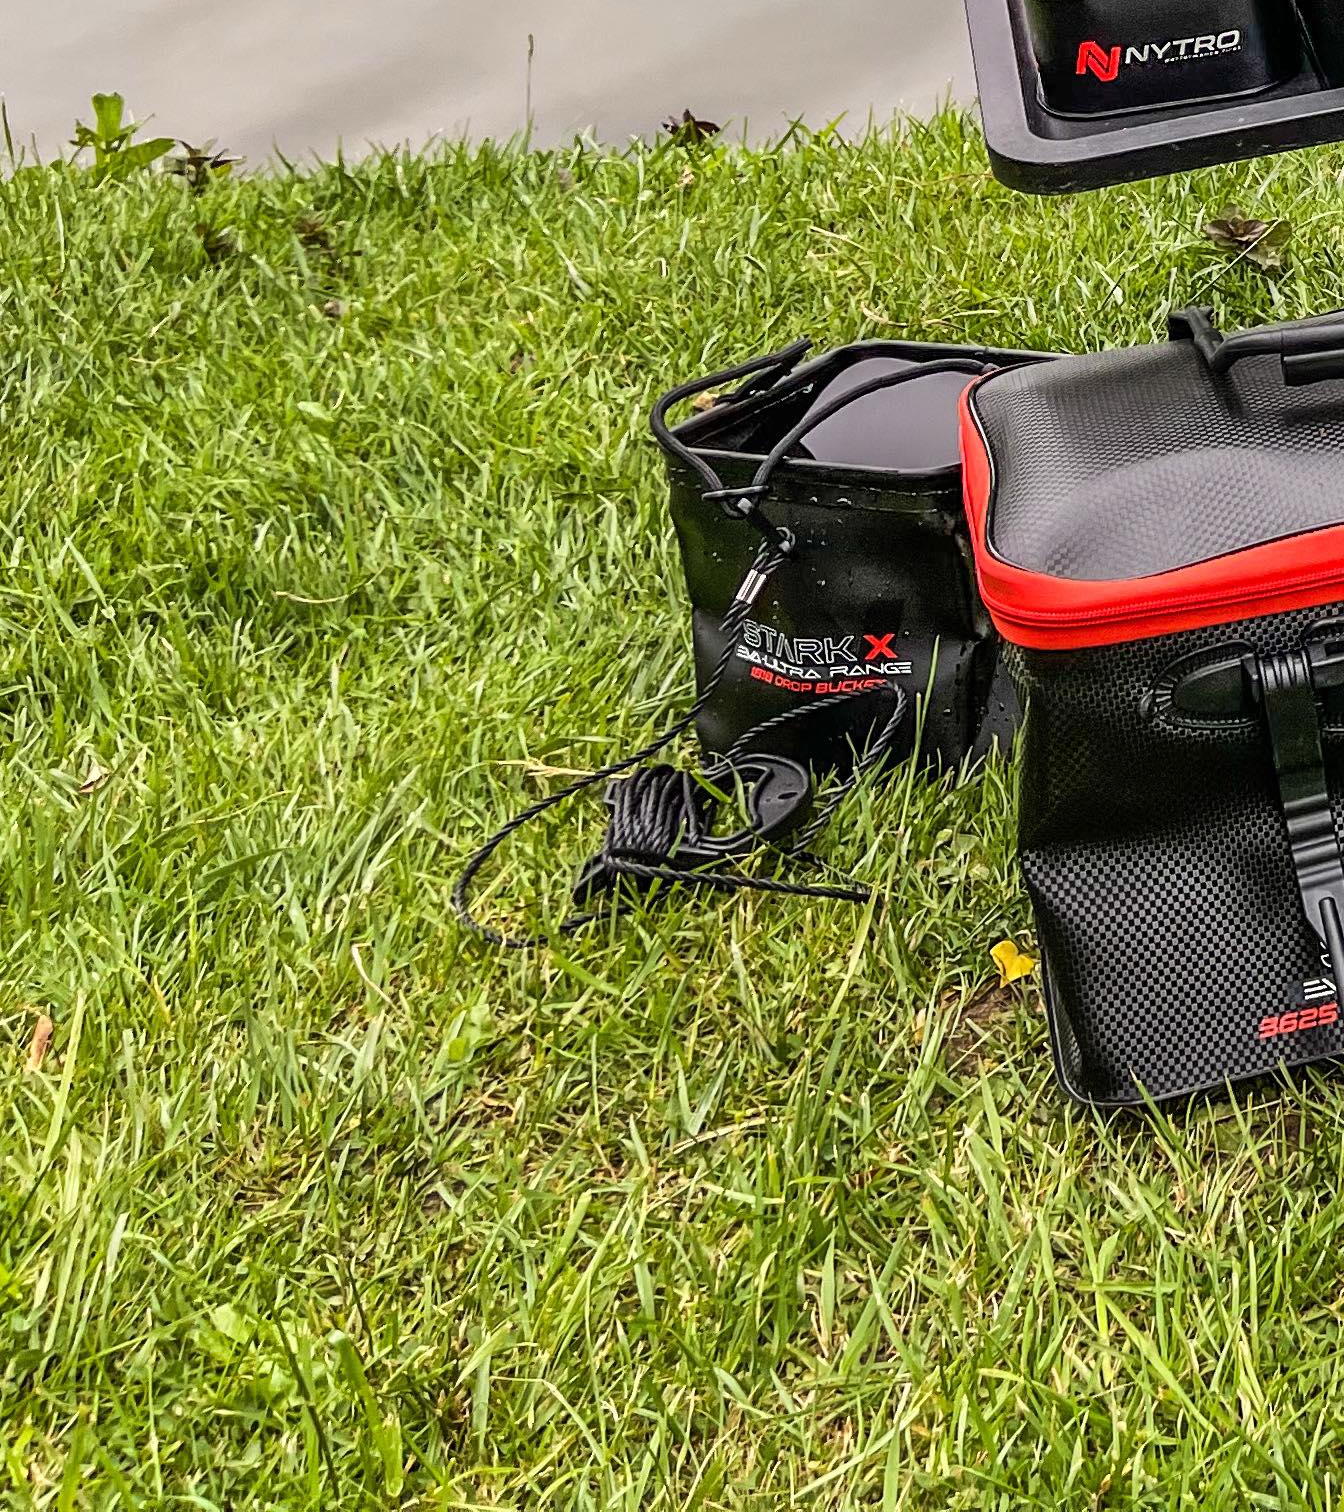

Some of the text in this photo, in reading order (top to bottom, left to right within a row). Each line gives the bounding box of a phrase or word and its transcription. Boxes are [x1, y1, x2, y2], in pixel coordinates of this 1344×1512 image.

[1125, 29, 1240, 64] NYTRO
[829, 661, 912, 678] RANGE
[775, 675, 812, 693] DROP
